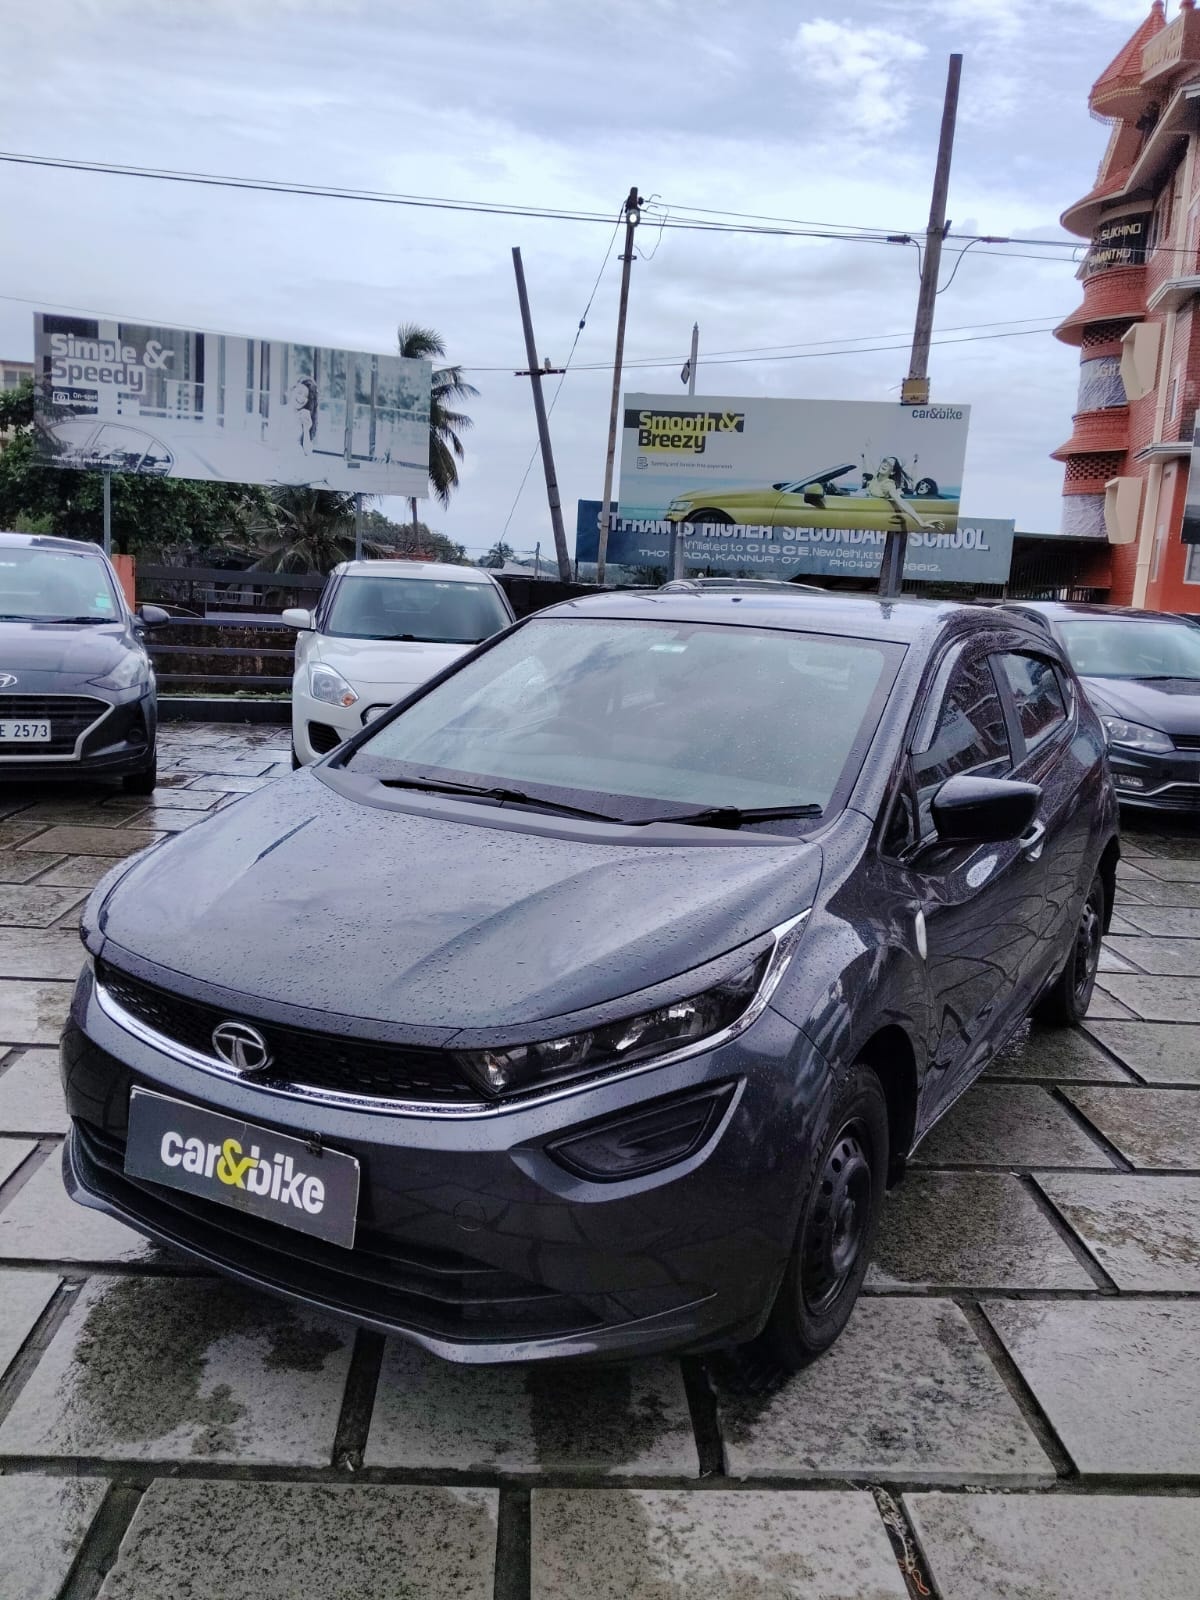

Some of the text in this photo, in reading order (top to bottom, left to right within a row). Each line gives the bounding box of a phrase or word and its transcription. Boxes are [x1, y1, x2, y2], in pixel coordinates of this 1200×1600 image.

[51, 333, 175, 370] Simple &
[52, 357, 144, 393] Speedy
[639, 409, 744, 433] Smooth &
[912, 407, 963, 420] car&bike
[638, 429, 706, 454] Breezy
[731, 543, 745, 552] to
[782, 526, 888, 545] SECONDAR
[0, 724, 48, 738] E 2573
[160, 1131, 326, 1214] car&bike
